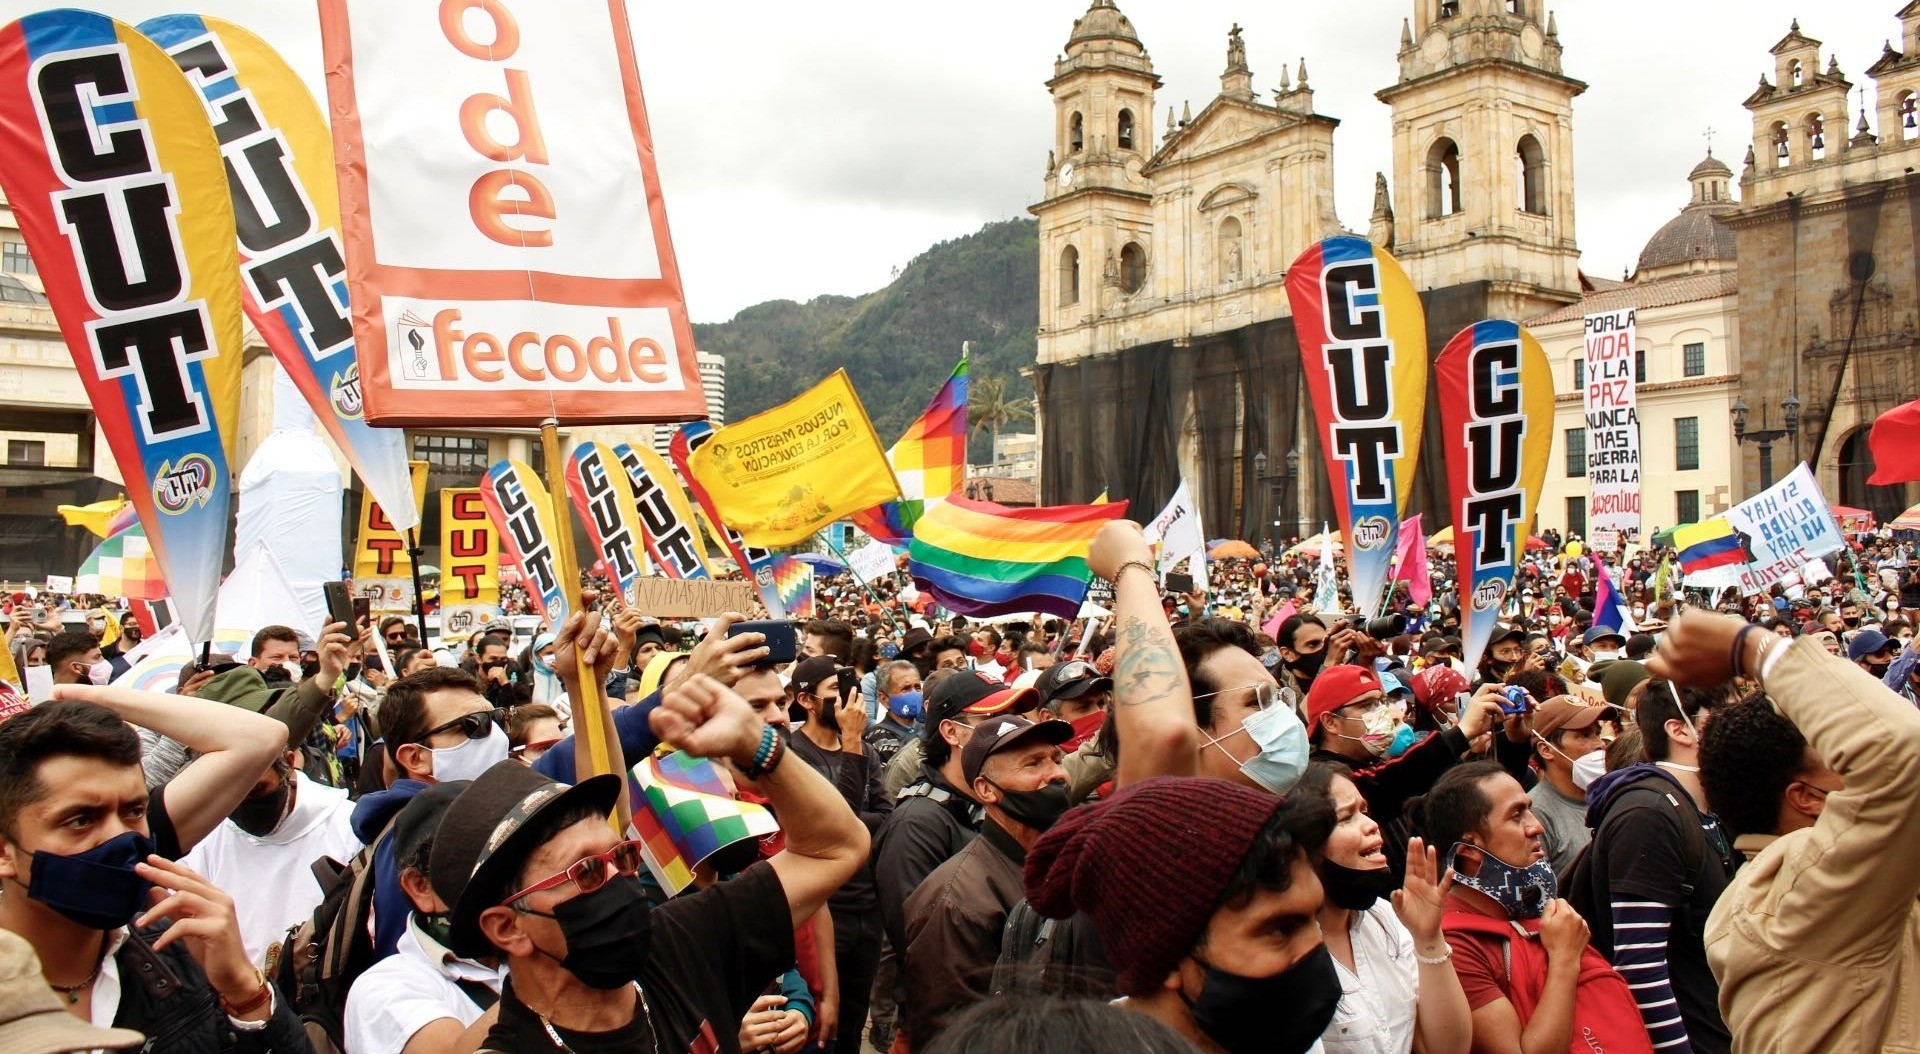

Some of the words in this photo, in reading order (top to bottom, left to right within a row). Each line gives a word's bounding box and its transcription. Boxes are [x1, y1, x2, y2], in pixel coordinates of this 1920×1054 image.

[36, 51, 212, 436] CUT
[433, 308, 668, 384] fecode
[1324, 263, 1398, 500] CUT
[1587, 333, 1630, 362] VIDA
[1589, 364, 1597, 382] Y
[1604, 360, 1629, 378] LA
[1585, 407, 1637, 430] NUNCA
[1590, 380, 1629, 408] PAZ
[1467, 343, 1523, 566] CUT
[1588, 450, 1638, 468] GUERRA
[1590, 469, 1617, 484] PARA
[1621, 469, 1639, 483] LA
[1594, 427, 1629, 450] MÁS
[451, 493, 489, 599] CUT
[496, 471, 556, 595] CUT
[580, 453, 635, 578] CUT
[620, 454, 698, 574] CUT
